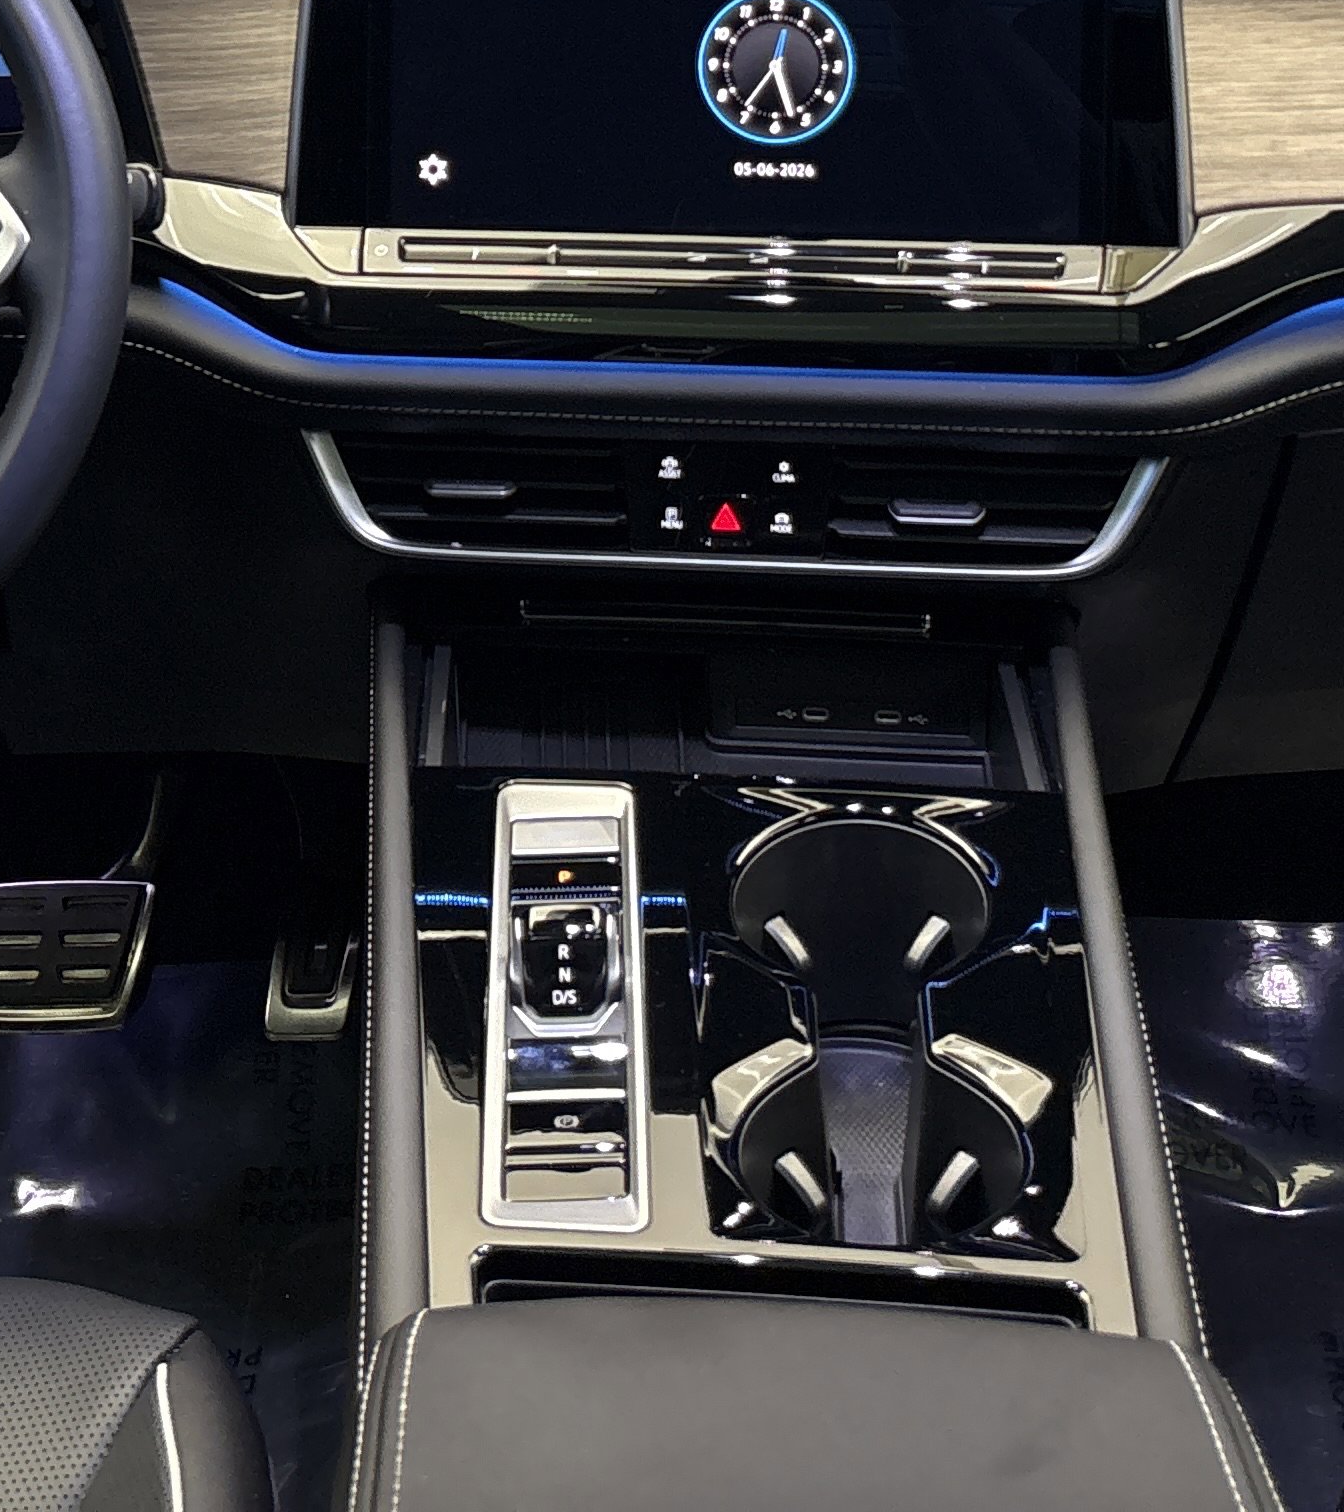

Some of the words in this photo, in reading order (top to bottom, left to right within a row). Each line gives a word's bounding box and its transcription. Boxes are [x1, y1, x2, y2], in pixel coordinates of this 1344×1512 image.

[739, 5, 753, 19] 11
[714, 26, 730, 41] 10
[822, 28, 835, 43] 2
[707, 57, 719, 72] 9
[831, 59, 843, 74] 3
[716, 88, 729, 103] 8
[739, 110, 750, 124] 7
[799, 112, 811, 127] 5
[768, 120, 781, 135] 6
[733, 161, 816, 178] 05-06-2026
[557, 943, 570, 961] R
[558, 967, 572, 983] N
[551, 989, 578, 1006] D/S
[284, 1044, 318, 1156] EMOVE
